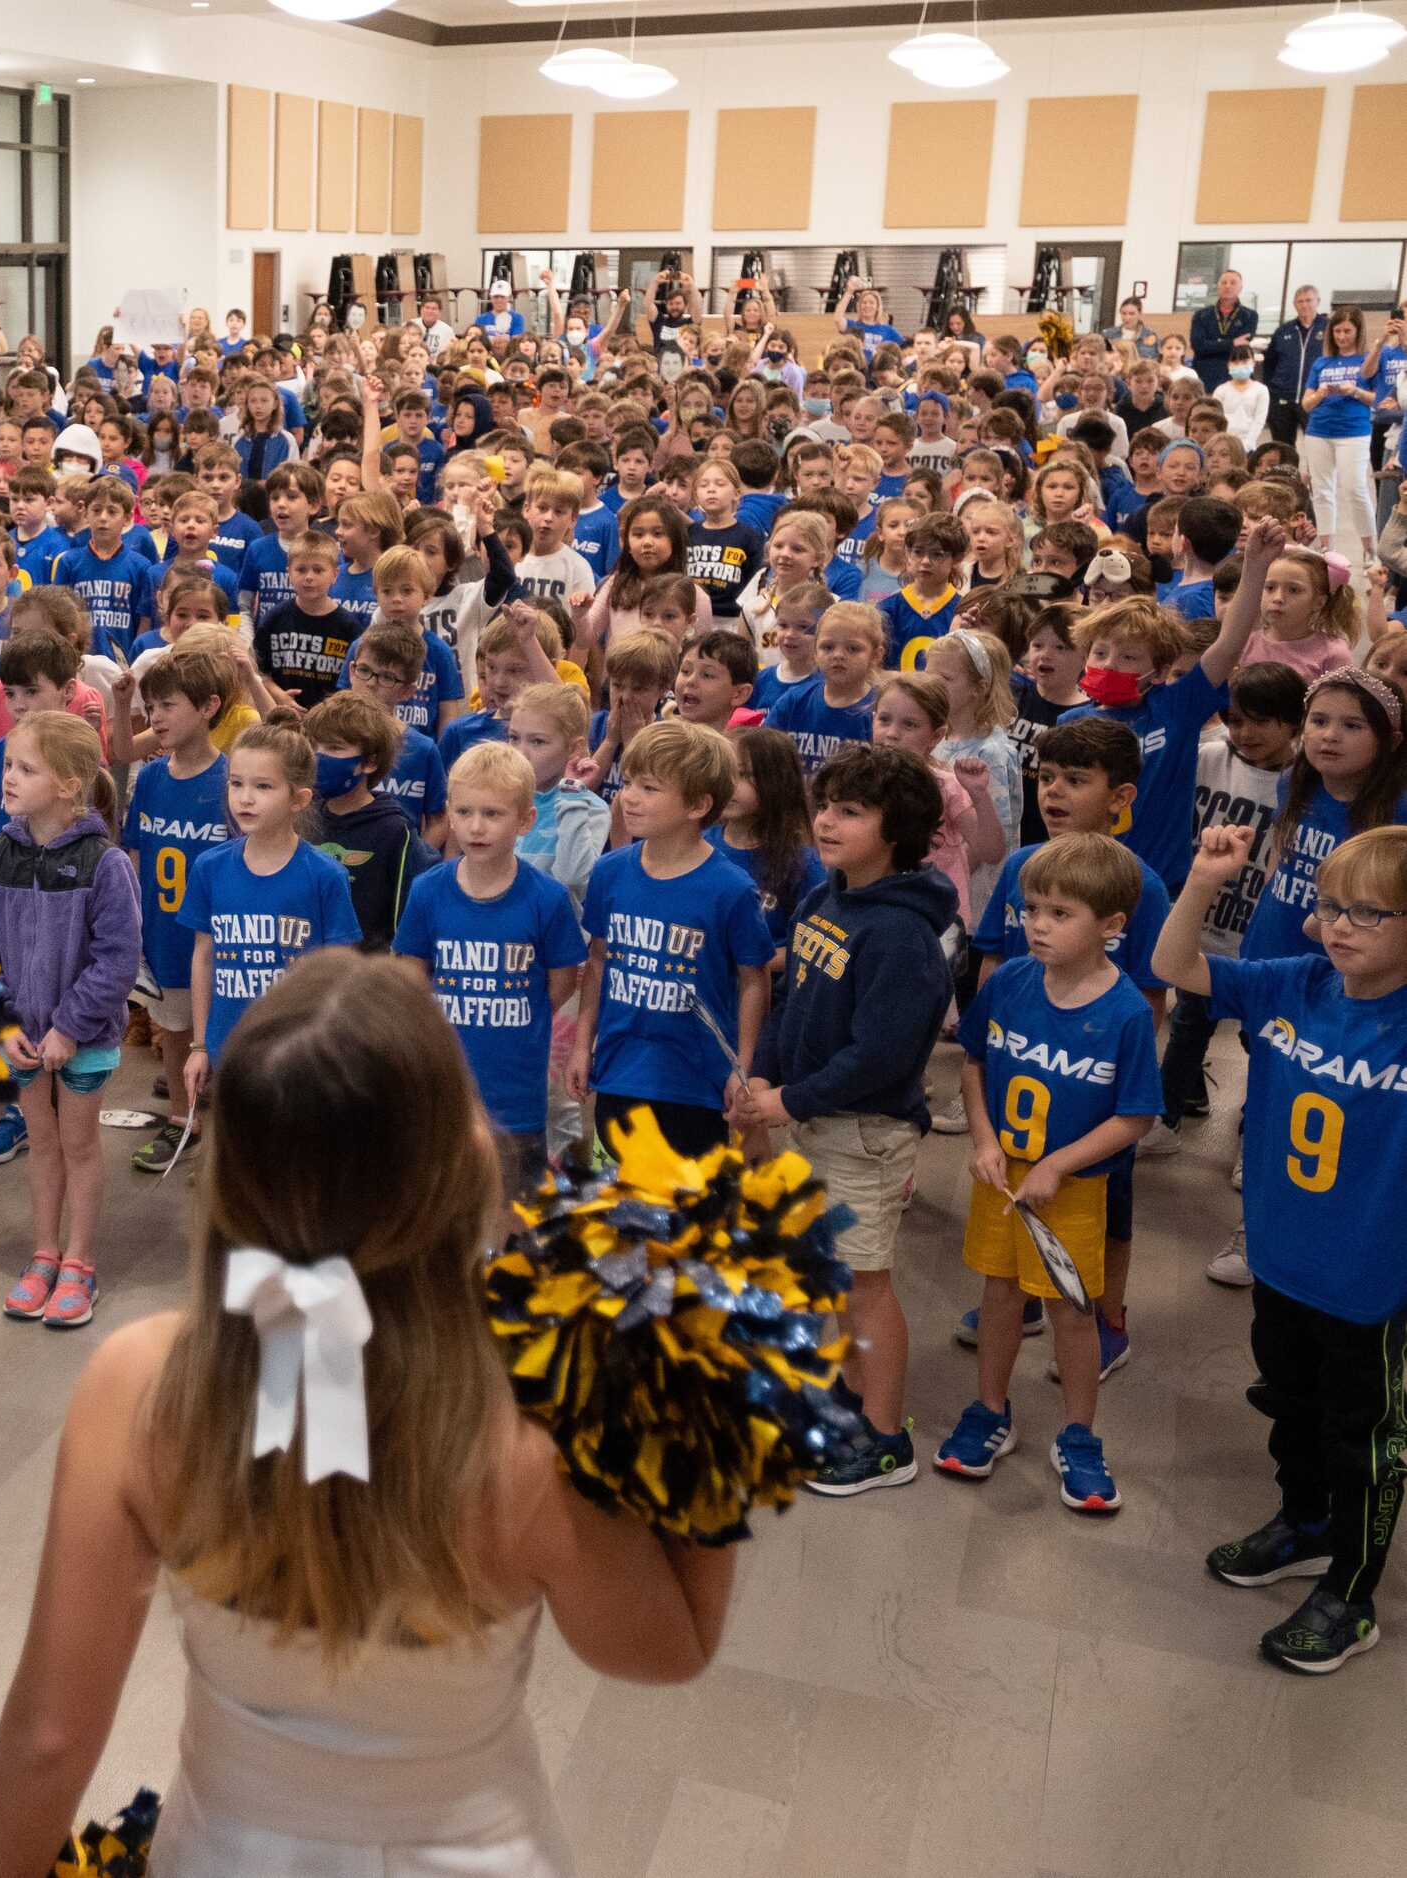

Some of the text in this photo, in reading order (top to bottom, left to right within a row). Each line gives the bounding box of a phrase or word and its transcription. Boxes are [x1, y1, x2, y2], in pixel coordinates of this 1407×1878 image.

[687, 546, 723, 563] COTS
[114, 581, 132, 599] UP
[91, 609, 131, 629] FFORD
[270, 632, 324, 654] SCOTS
[153, 816, 229, 842] RAMS
[156, 847, 187, 913] 9
[210, 914, 312, 949] STAND UP
[666, 922, 706, 961] UP
[243, 950, 276, 963] FOR
[504, 943, 536, 973] UP
[628, 953, 658, 972] FOR
[792, 922, 851, 980] SCOTS
[462, 976, 497, 992] FOR
[1004, 1030, 1117, 1086] RAMS
[999, 1074, 1052, 1163] 9
[1286, 1091, 1345, 1193] 9
